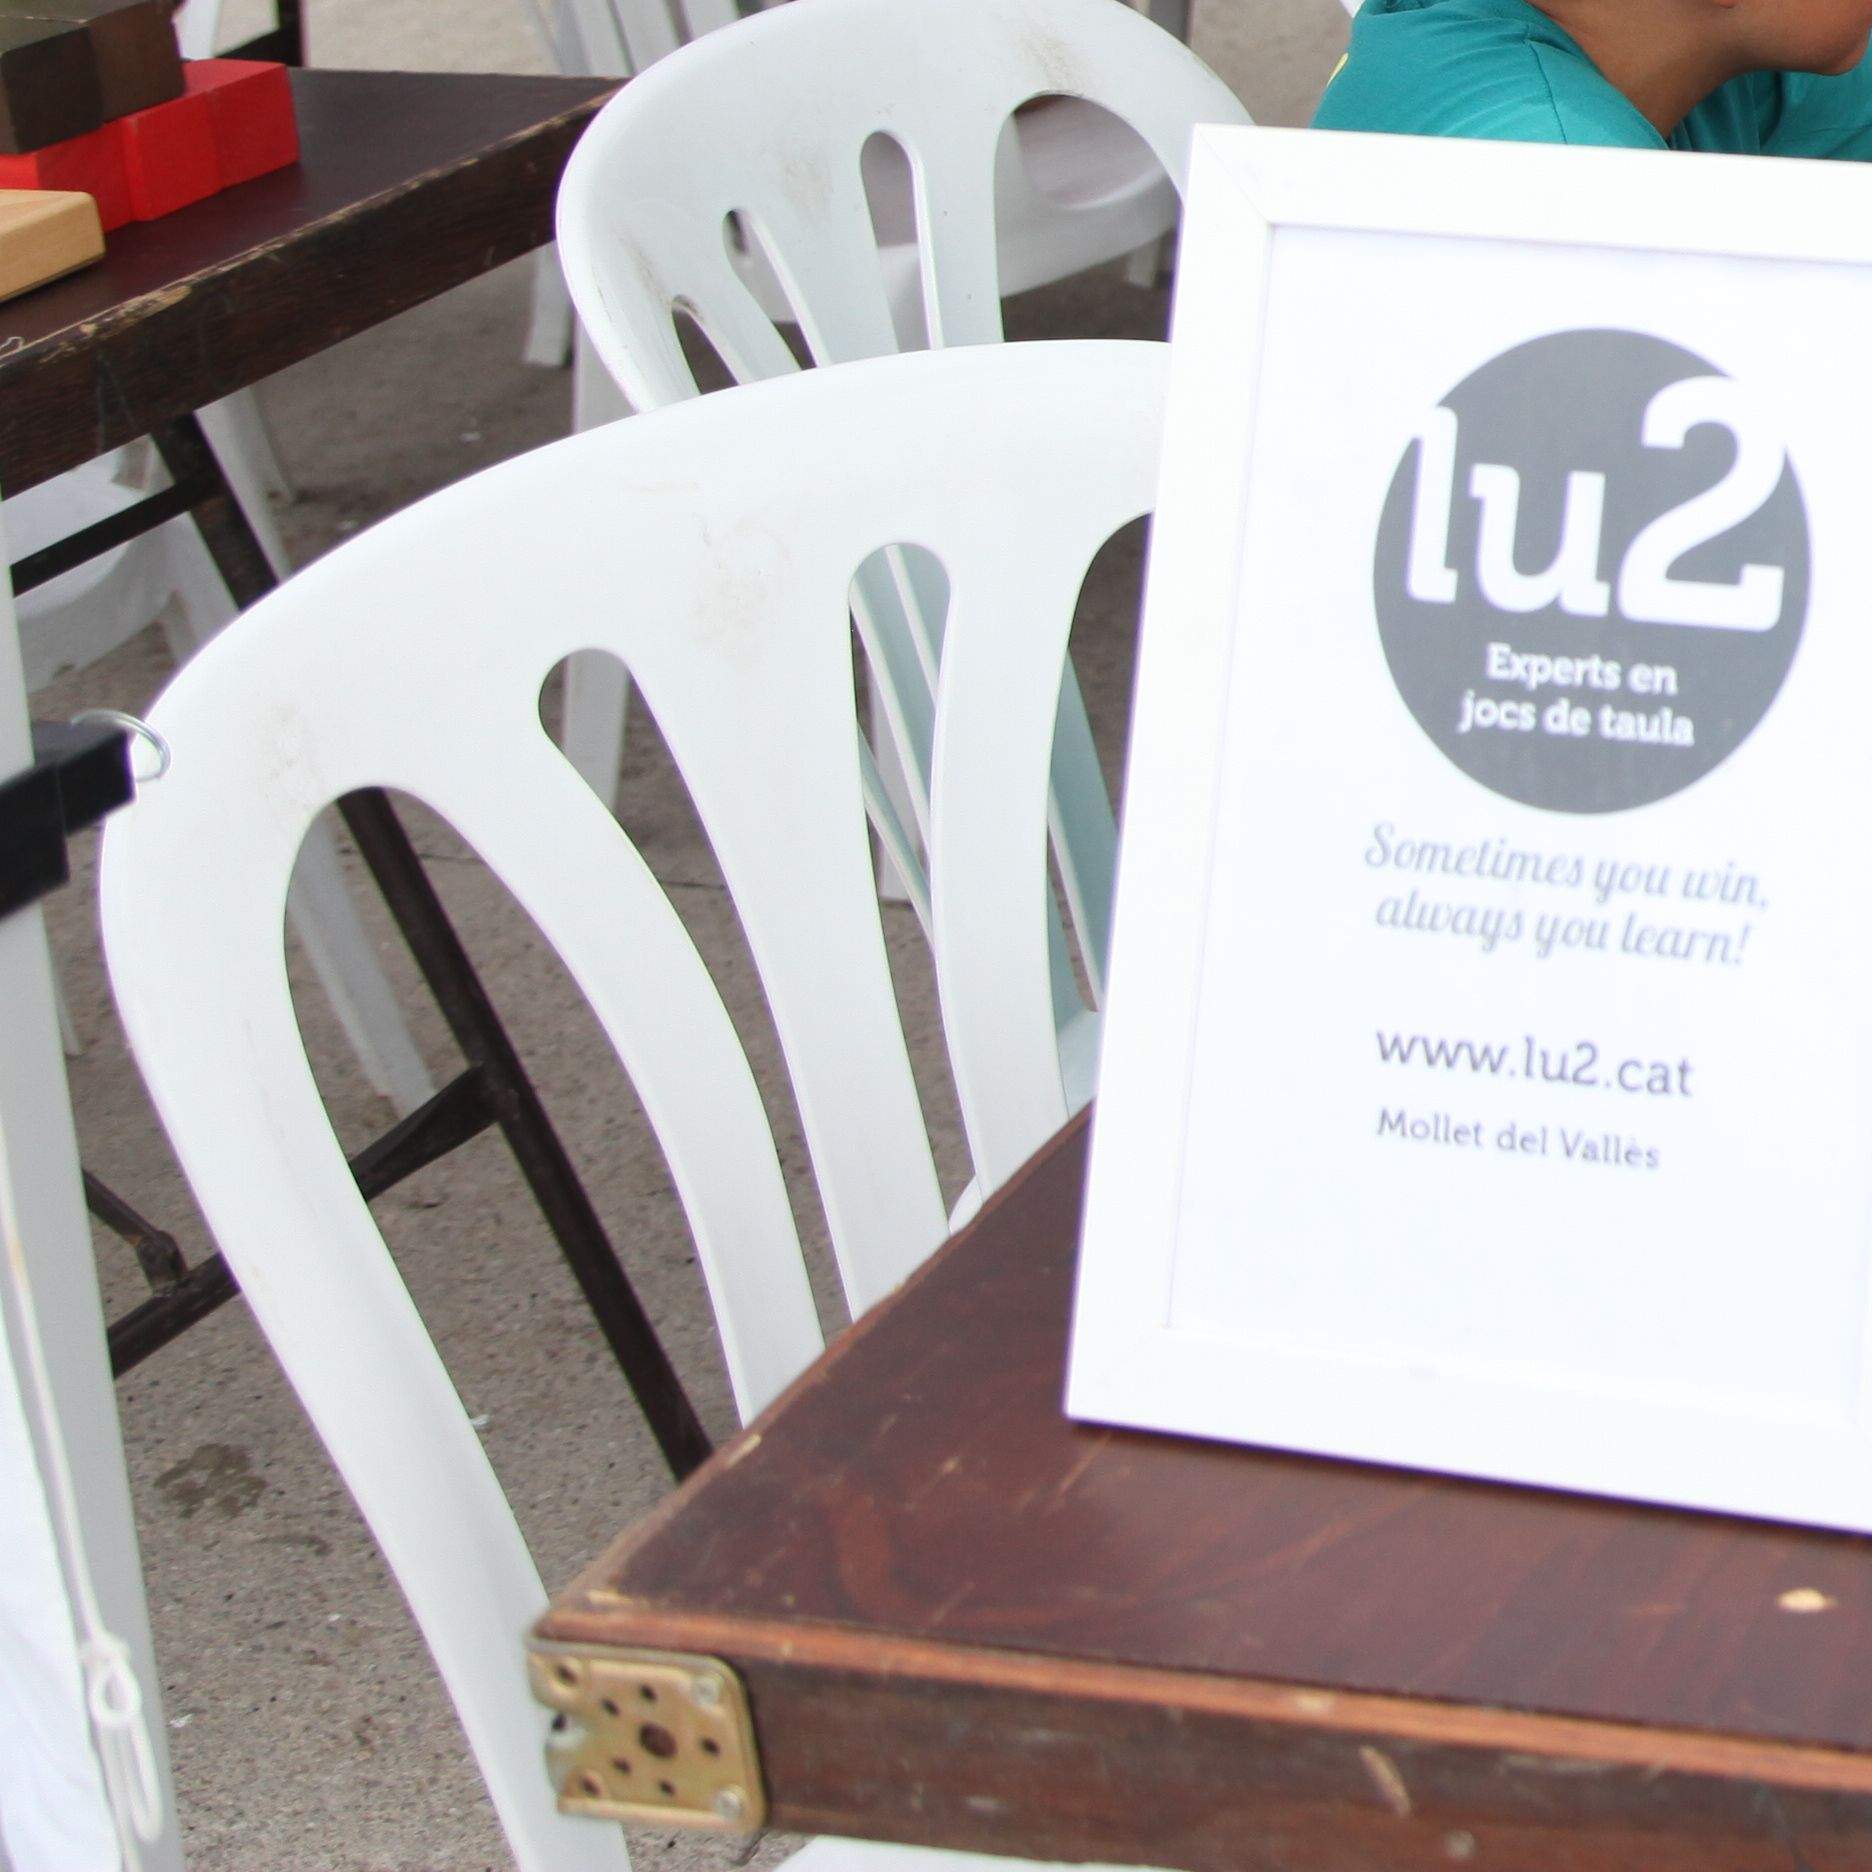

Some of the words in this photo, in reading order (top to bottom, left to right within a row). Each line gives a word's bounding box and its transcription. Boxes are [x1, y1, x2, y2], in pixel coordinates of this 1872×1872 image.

[1401, 374, 1788, 633] lu2
[1486, 641, 1622, 690] Experts
[1628, 662, 1678, 695] en
[1457, 689, 1536, 733] jocs
[1542, 697, 1591, 736] de
[1599, 704, 1696, 747] taula
[1363, 820, 1585, 889] Sometimes
[1592, 858, 1671, 906] you
[1681, 861, 1769, 912] win,
[1374, 889, 1524, 954] always
[1533, 911, 1610, 959] you
[1619, 912, 1753, 965] learn!
[1376, 1029, 1695, 1097] www.lu2.cat
[1376, 1107, 1483, 1148] Mollet
[1496, 1122, 1548, 1155] del
[1559, 1127, 1661, 1170] Vallès
